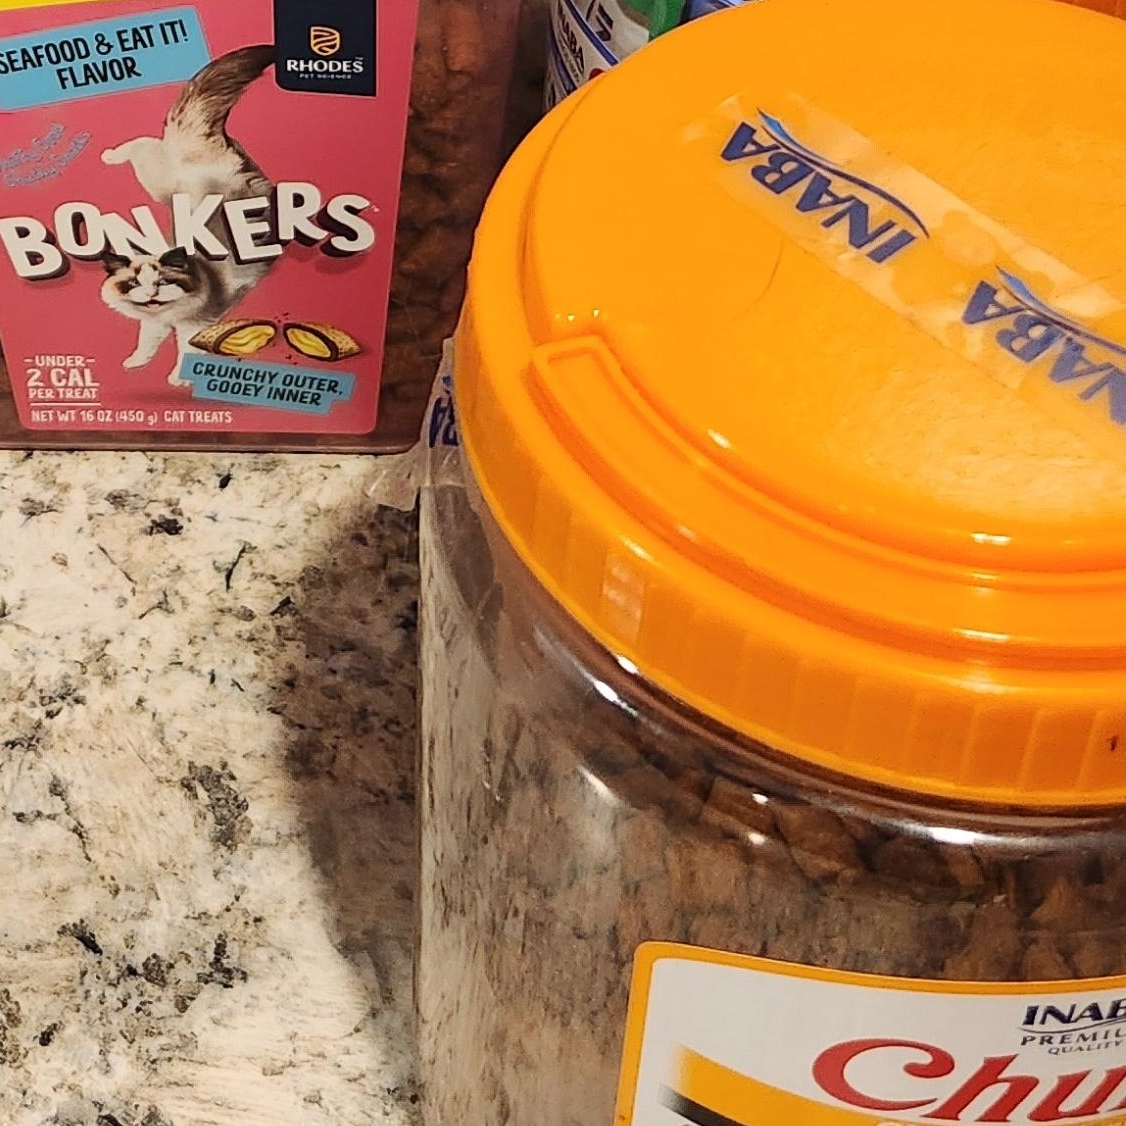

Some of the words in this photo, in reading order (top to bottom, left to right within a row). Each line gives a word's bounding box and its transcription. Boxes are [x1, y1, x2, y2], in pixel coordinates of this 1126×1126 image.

[94, 32, 114, 55] &
[116, 24, 156, 52] EAT
[159, 19, 189, 45] IT!
[56, 56, 142, 90] FLAVOR
[721, 121, 916, 263] INABA
[26, 368, 45, 388] 2
[50, 368, 100, 388] CAL
[192, 361, 278, 385] CRUNCHY
[28, 388, 54, 399] PER
[58, 388, 98, 399] TREAT
[206, 379, 264, 399] GOOEY
[266, 388, 322, 406] INNER
[31, 410, 54, 422] NET
[57, 410, 75, 422] WT
[79, 410, 94, 422] 16
[97, 410, 113, 422] OZ
[115, 409, 145, 423] (450
[164, 410, 185, 422] CAT
[188, 410, 233, 423] TREATS
[1048, 1037, 1124, 1055] QUALITY
[812, 1038, 1126, 1123] Chu
